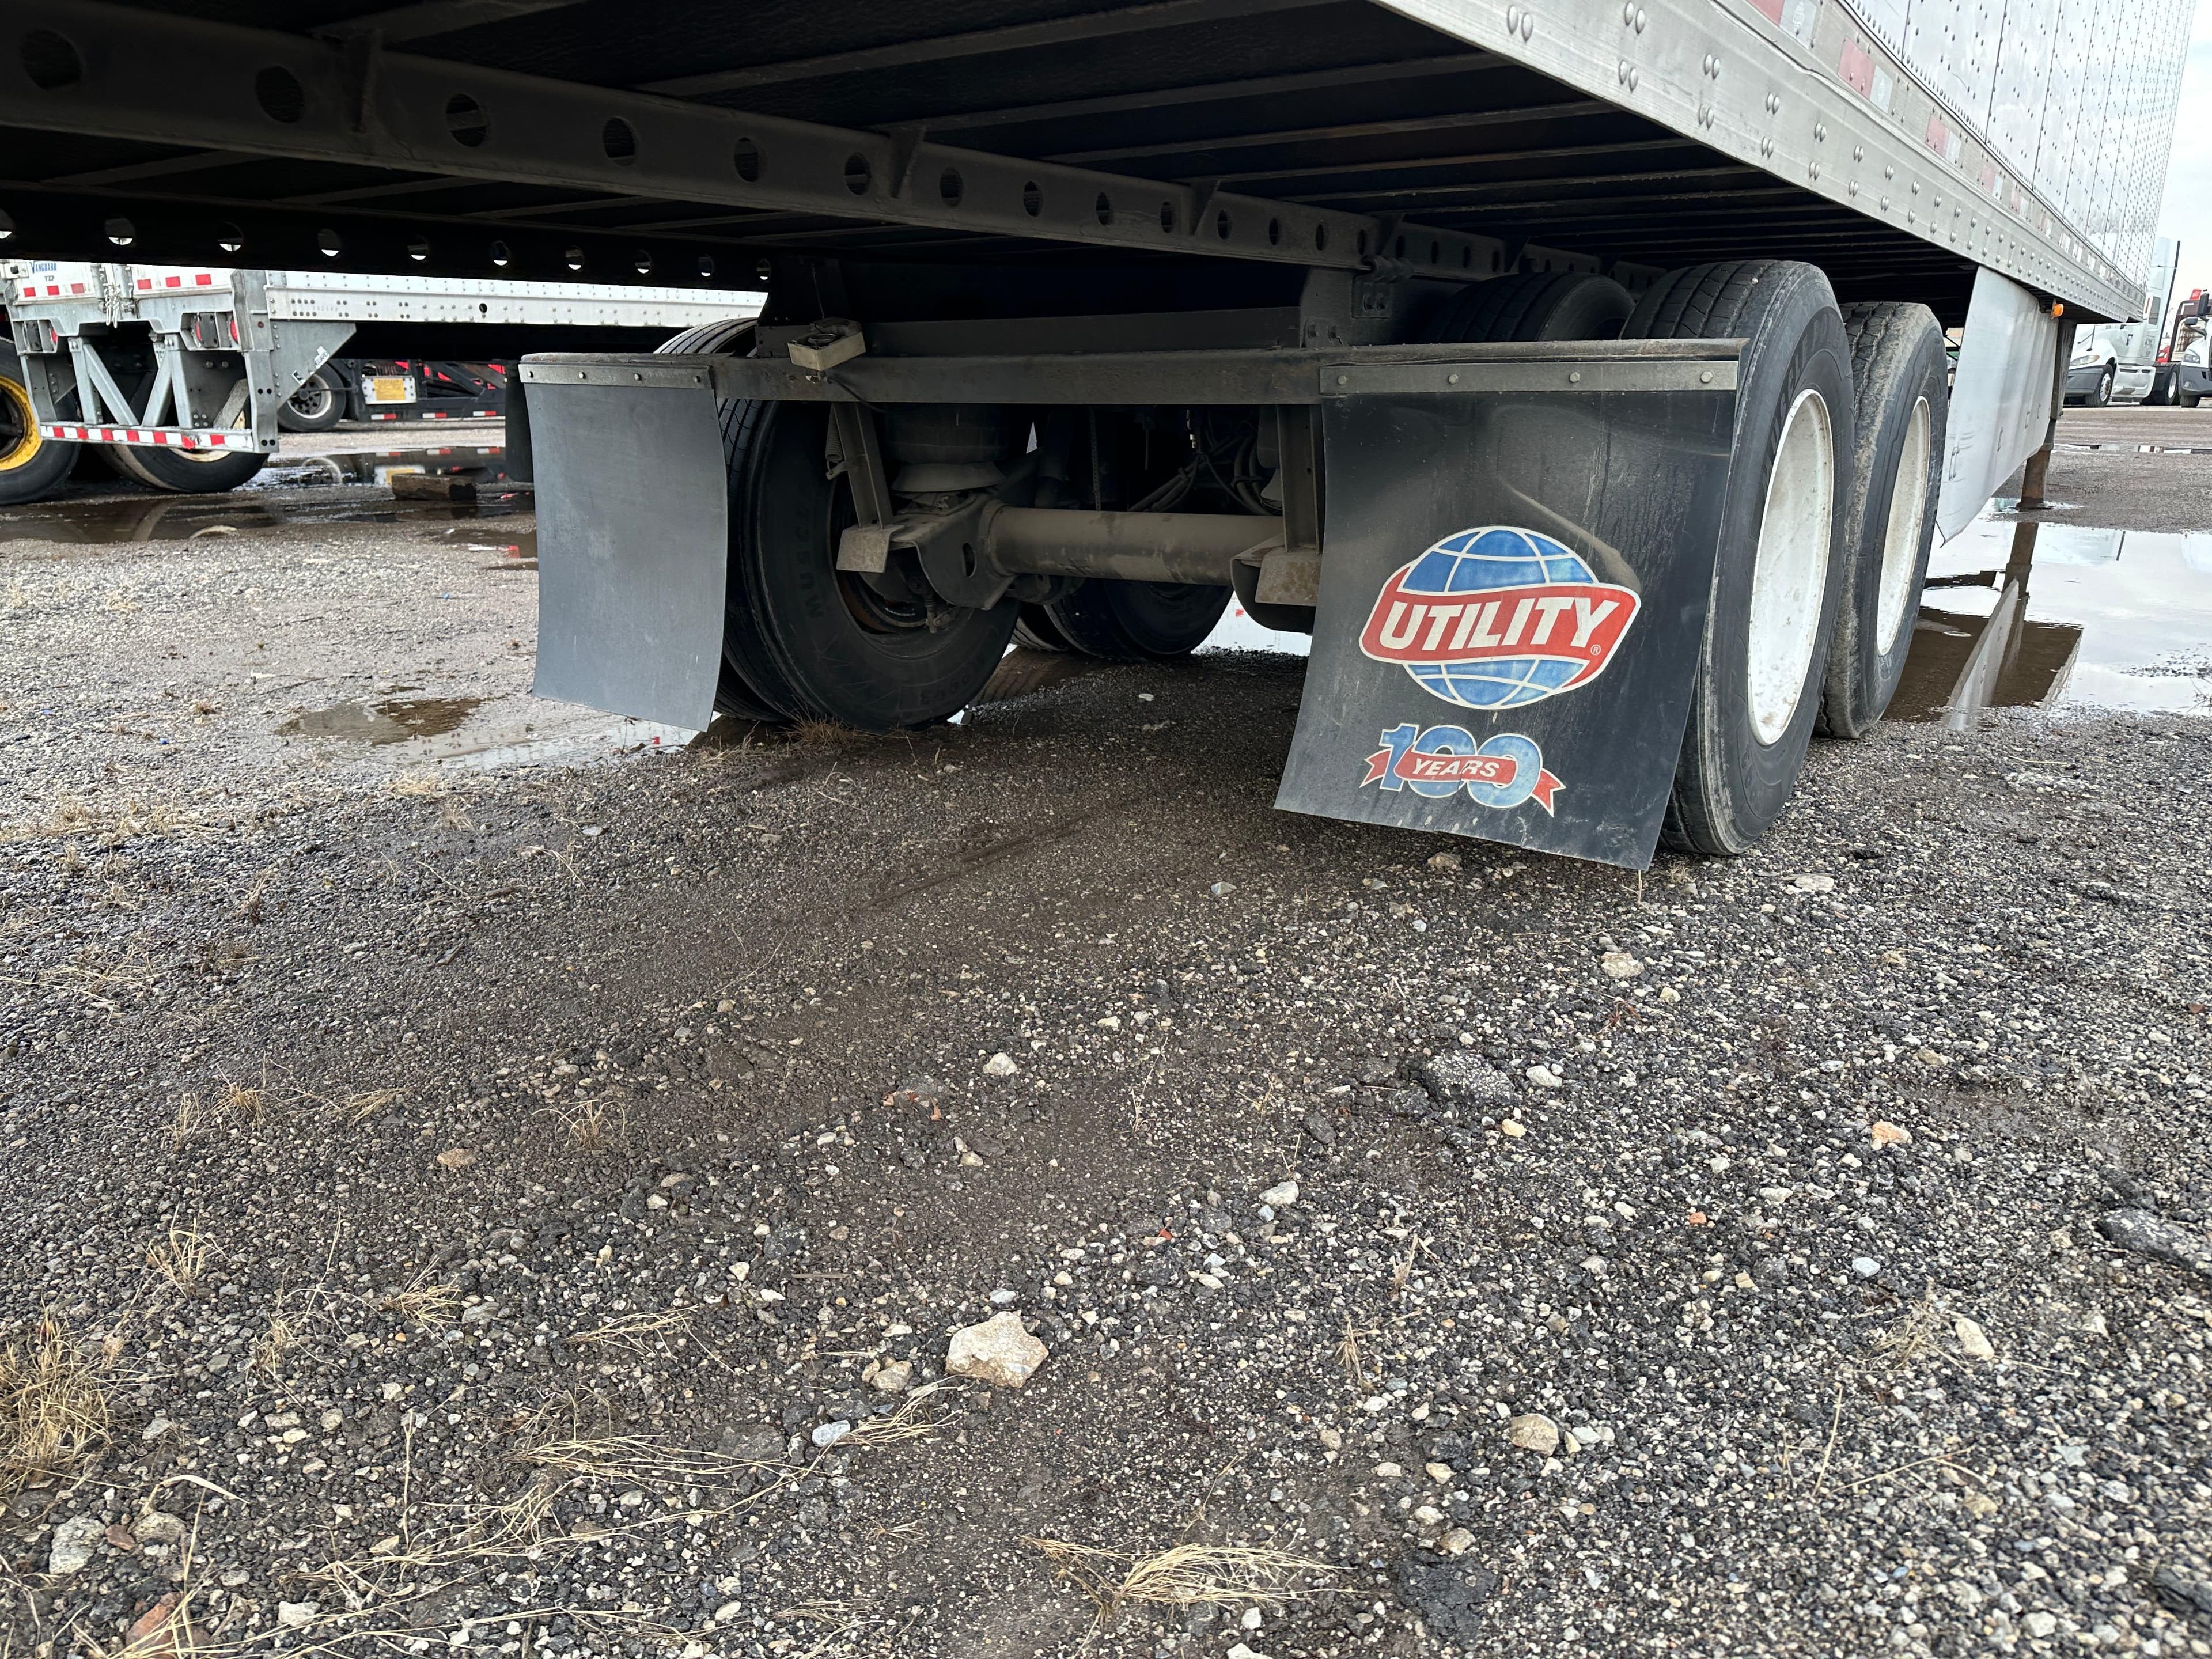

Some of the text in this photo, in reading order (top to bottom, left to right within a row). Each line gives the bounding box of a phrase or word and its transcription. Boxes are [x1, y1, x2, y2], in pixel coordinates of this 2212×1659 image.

[1378, 597, 1620, 652] UTILITY
[1378, 722, 1543, 809] 100
[1410, 756, 1500, 778] YEARS
